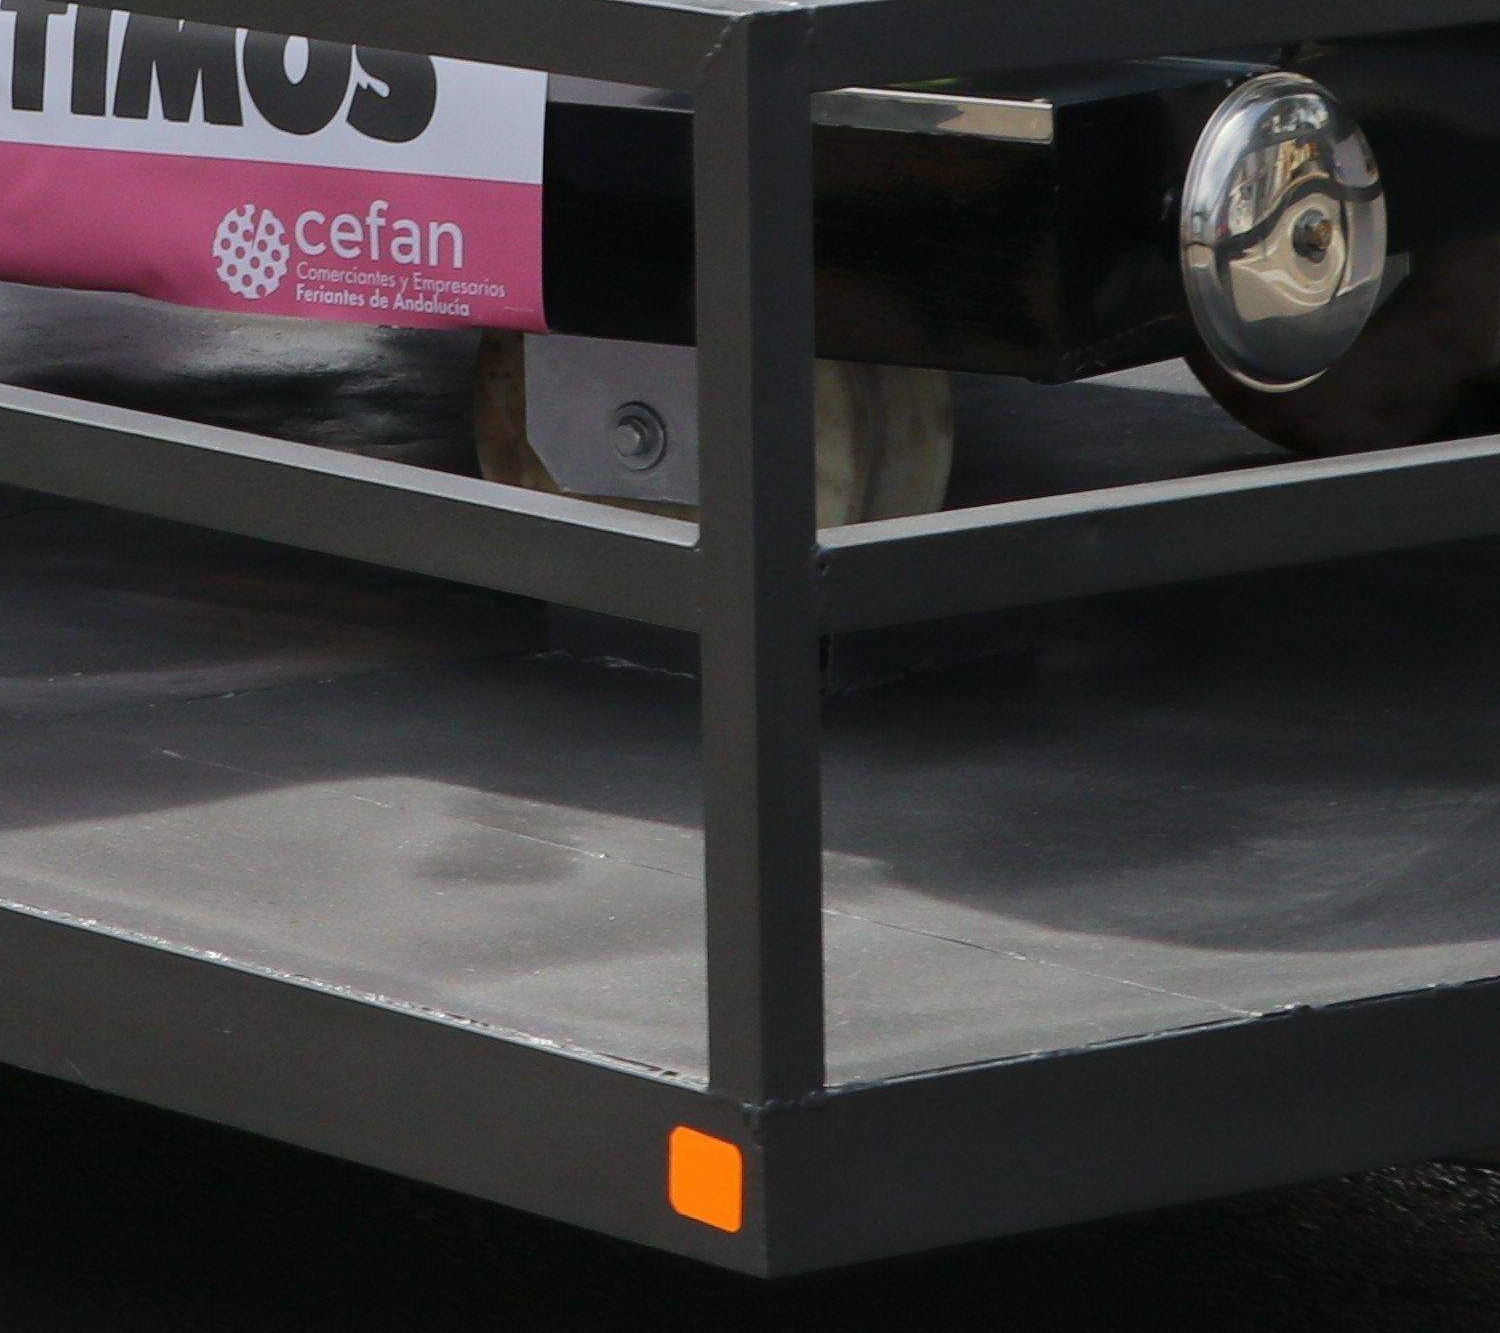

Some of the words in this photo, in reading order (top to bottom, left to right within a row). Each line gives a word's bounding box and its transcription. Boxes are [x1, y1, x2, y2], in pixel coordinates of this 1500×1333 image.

[293, 199, 466, 270] cefan
[296, 261, 396, 288] Comerciantes
[413, 272, 506, 298] Empresarios
[296, 283, 365, 307] Feriantes
[369, 288, 389, 309] de
[392, 293, 471, 317] Andalucía
